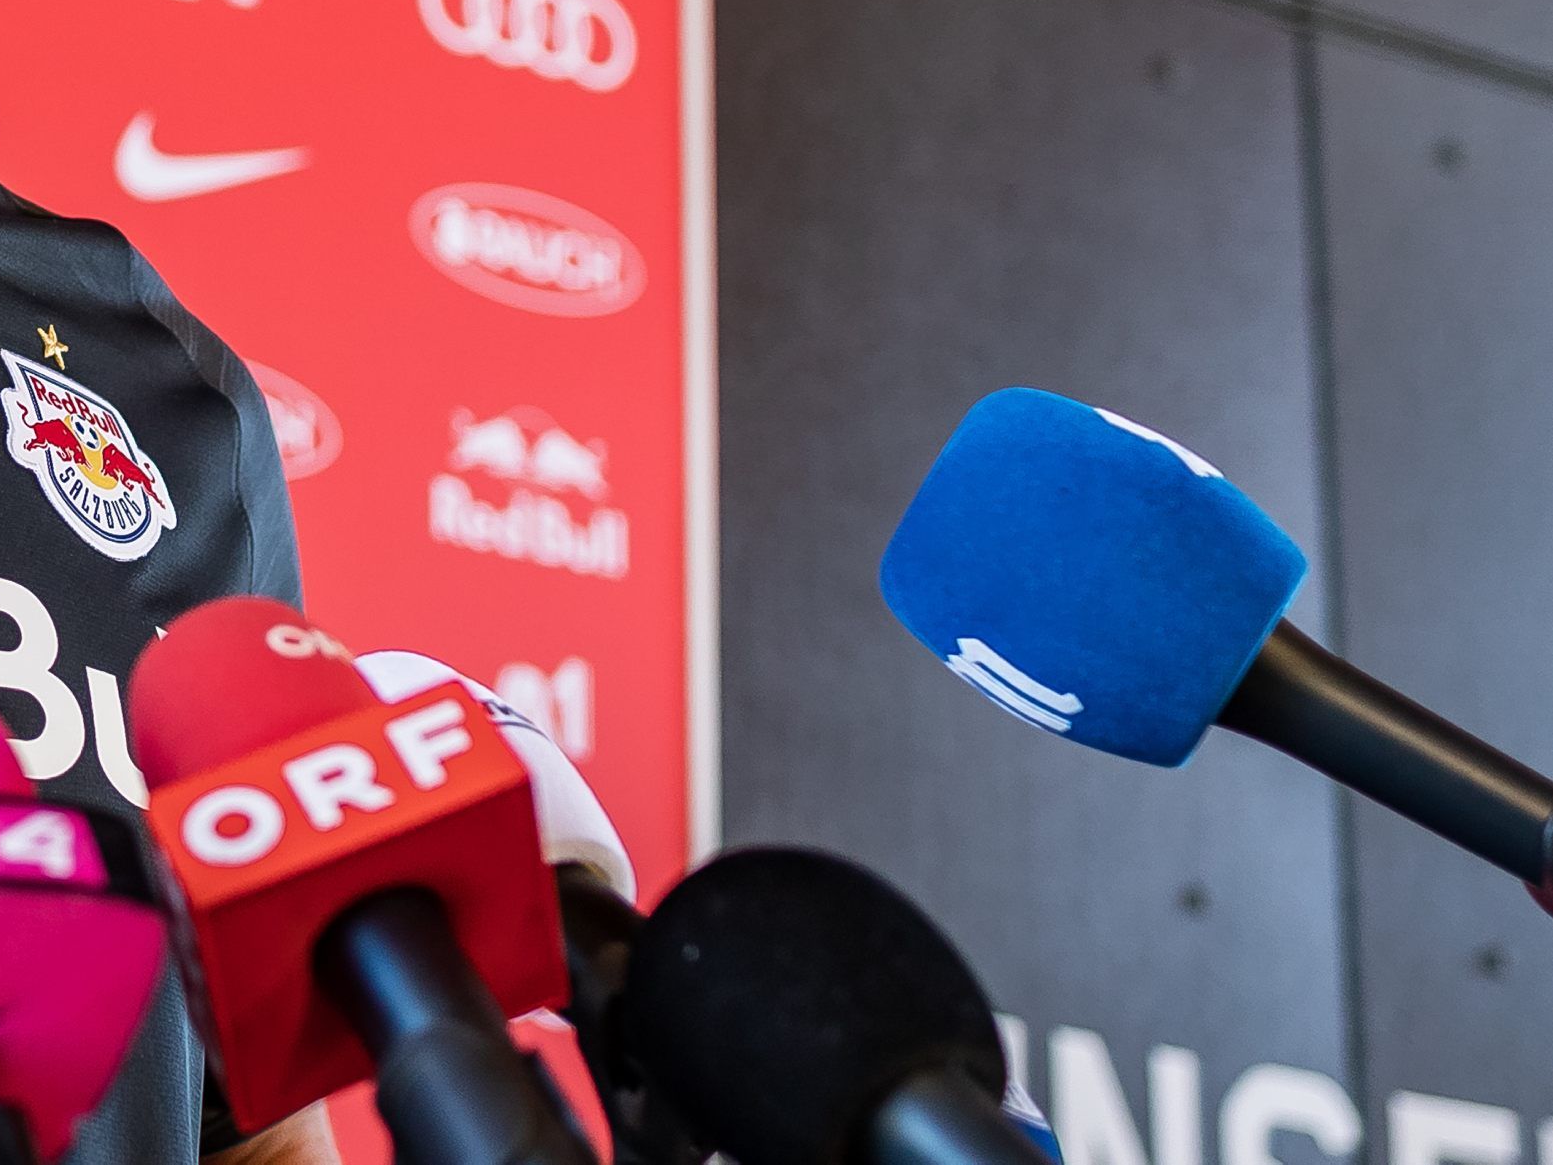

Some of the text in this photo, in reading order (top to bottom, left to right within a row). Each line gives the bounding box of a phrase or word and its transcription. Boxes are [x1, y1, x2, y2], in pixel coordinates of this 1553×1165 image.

[31, 376, 122, 439] Red Bull
[59, 466, 143, 531] SALZBURG
[180, 698, 474, 868] ORF
